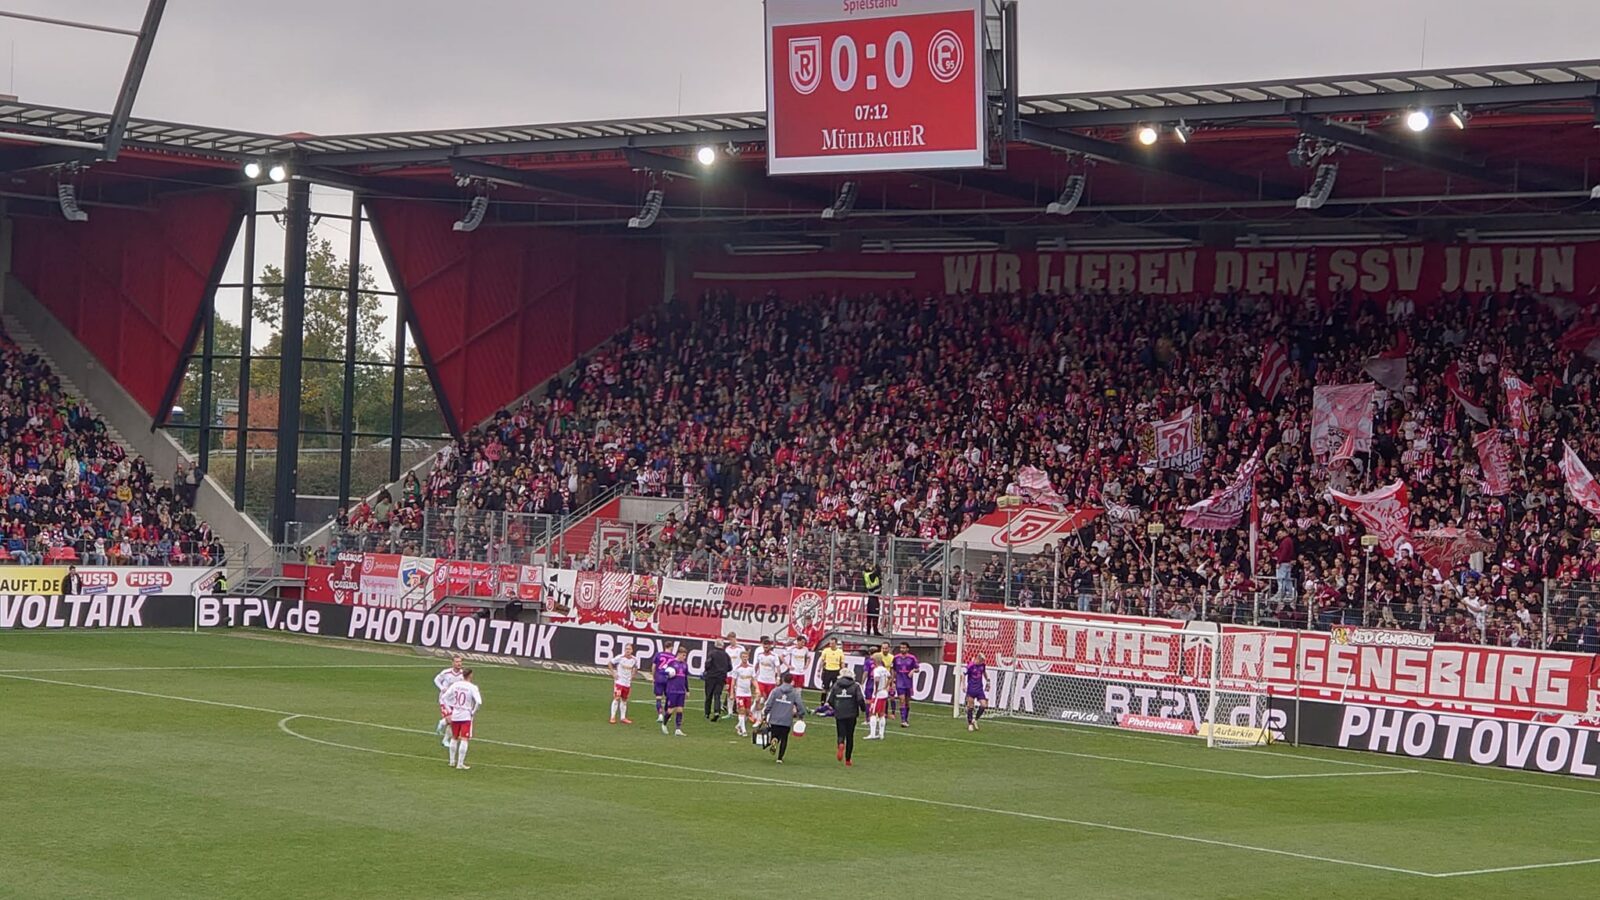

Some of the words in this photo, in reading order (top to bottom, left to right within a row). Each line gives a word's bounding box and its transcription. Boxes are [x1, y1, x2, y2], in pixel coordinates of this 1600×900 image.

[855, 104, 888, 120] 07:12
[821, 124, 926, 150] MÜHLBACHER
[943, 253, 1022, 295] WIR
[1037, 250, 1197, 295] LIEBEN
[1213, 250, 1309, 295] DEN
[1327, 246, 1425, 293] SSV
[1442, 245, 1576, 294] JAHN
[0, 579, 60, 593] AUFT.DE
[80, 572, 116, 586] USSL
[130, 572, 170, 586] FUSSL
[707, 584, 743, 597] Fanclub
[199, 597, 321, 634] BTPV.de
[660, 596, 767, 624] REGENSBURG
[768, 604, 788, 624] 81
[348, 606, 558, 660] PHOTOVOLTAIK
[1016, 617, 1172, 671] ULTRAS
[1232, 630, 1574, 706] REGENSBURG
[1127, 716, 1184, 732] Photovoltaik
[1214, 726, 1255, 739] Autarkie
